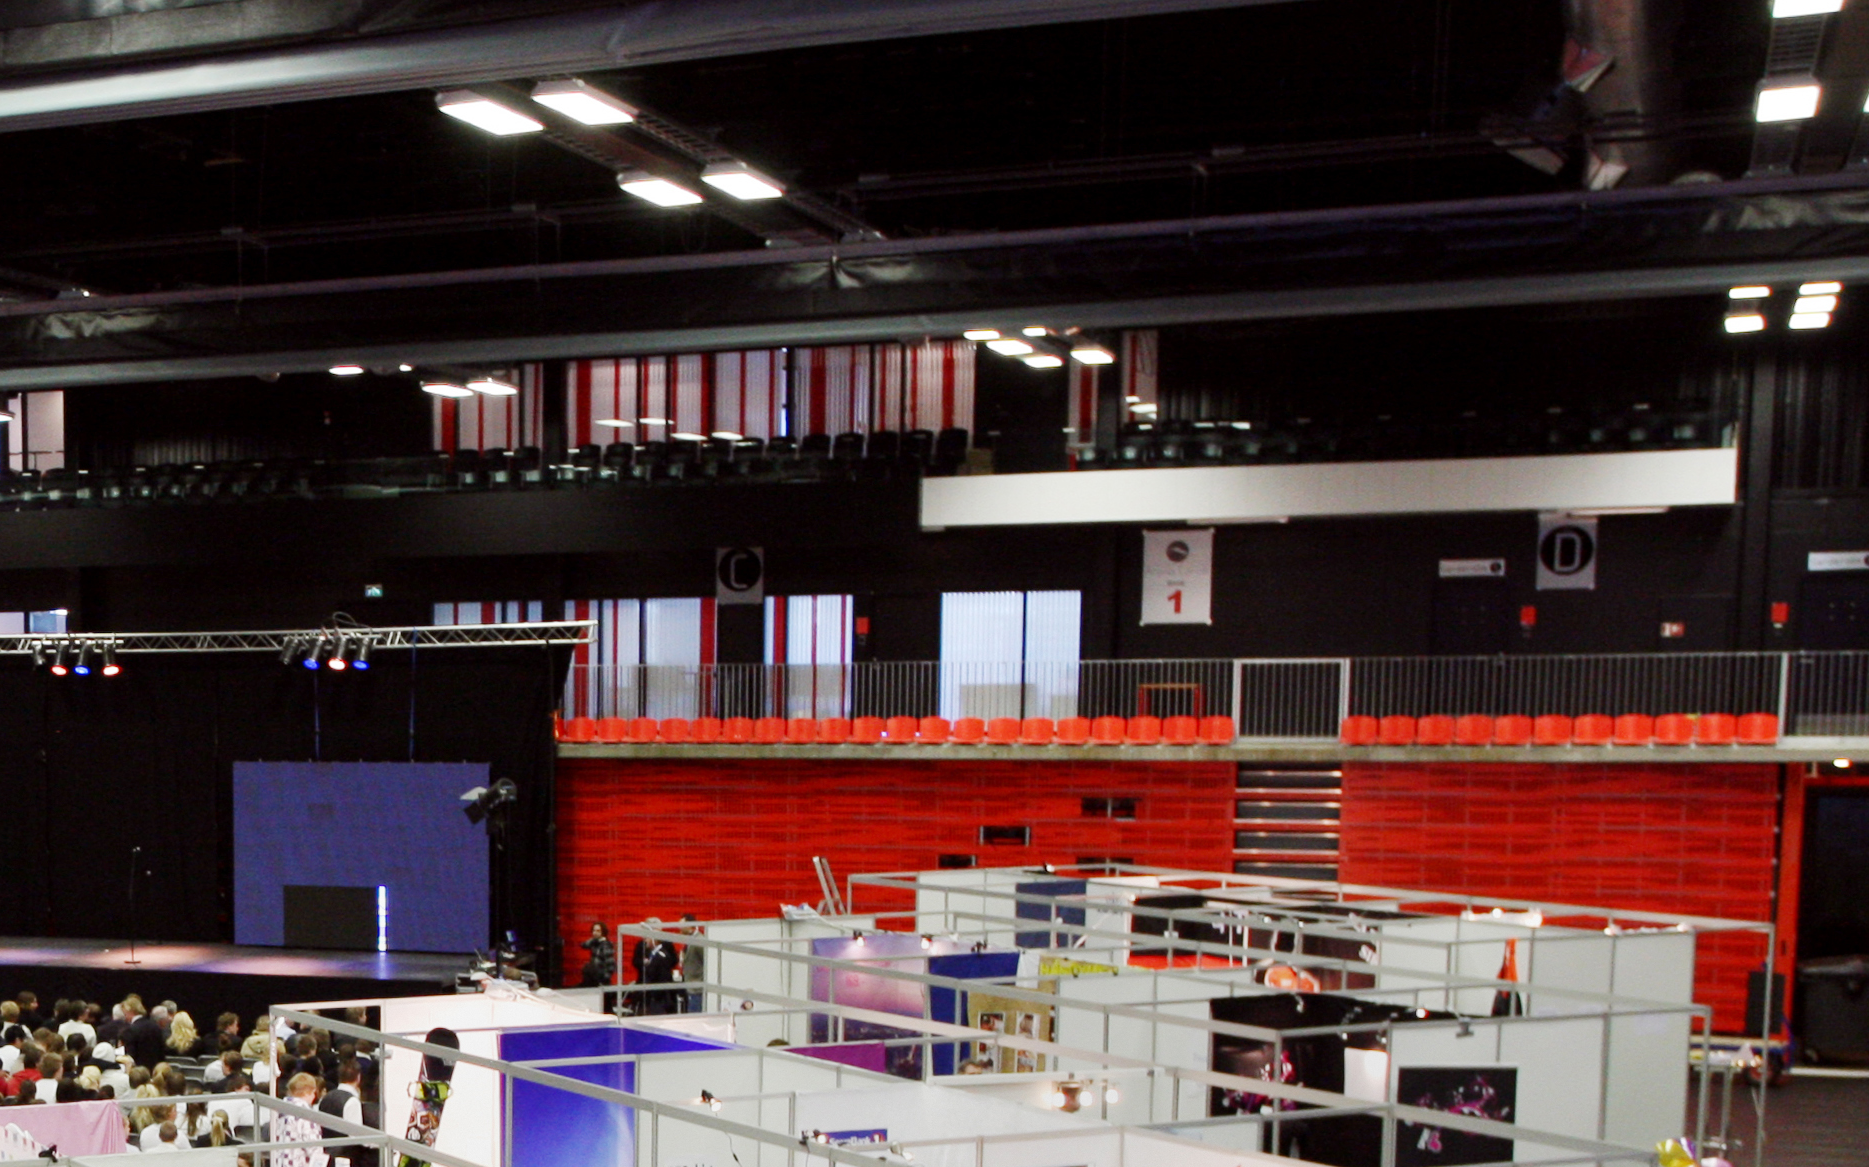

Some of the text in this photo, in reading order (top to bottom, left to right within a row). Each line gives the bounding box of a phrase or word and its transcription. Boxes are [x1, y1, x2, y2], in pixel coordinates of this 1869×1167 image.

[1554, 532, 1582, 572] D
[730, 553, 748, 589] C
[1167, 589, 1182, 614] 1
